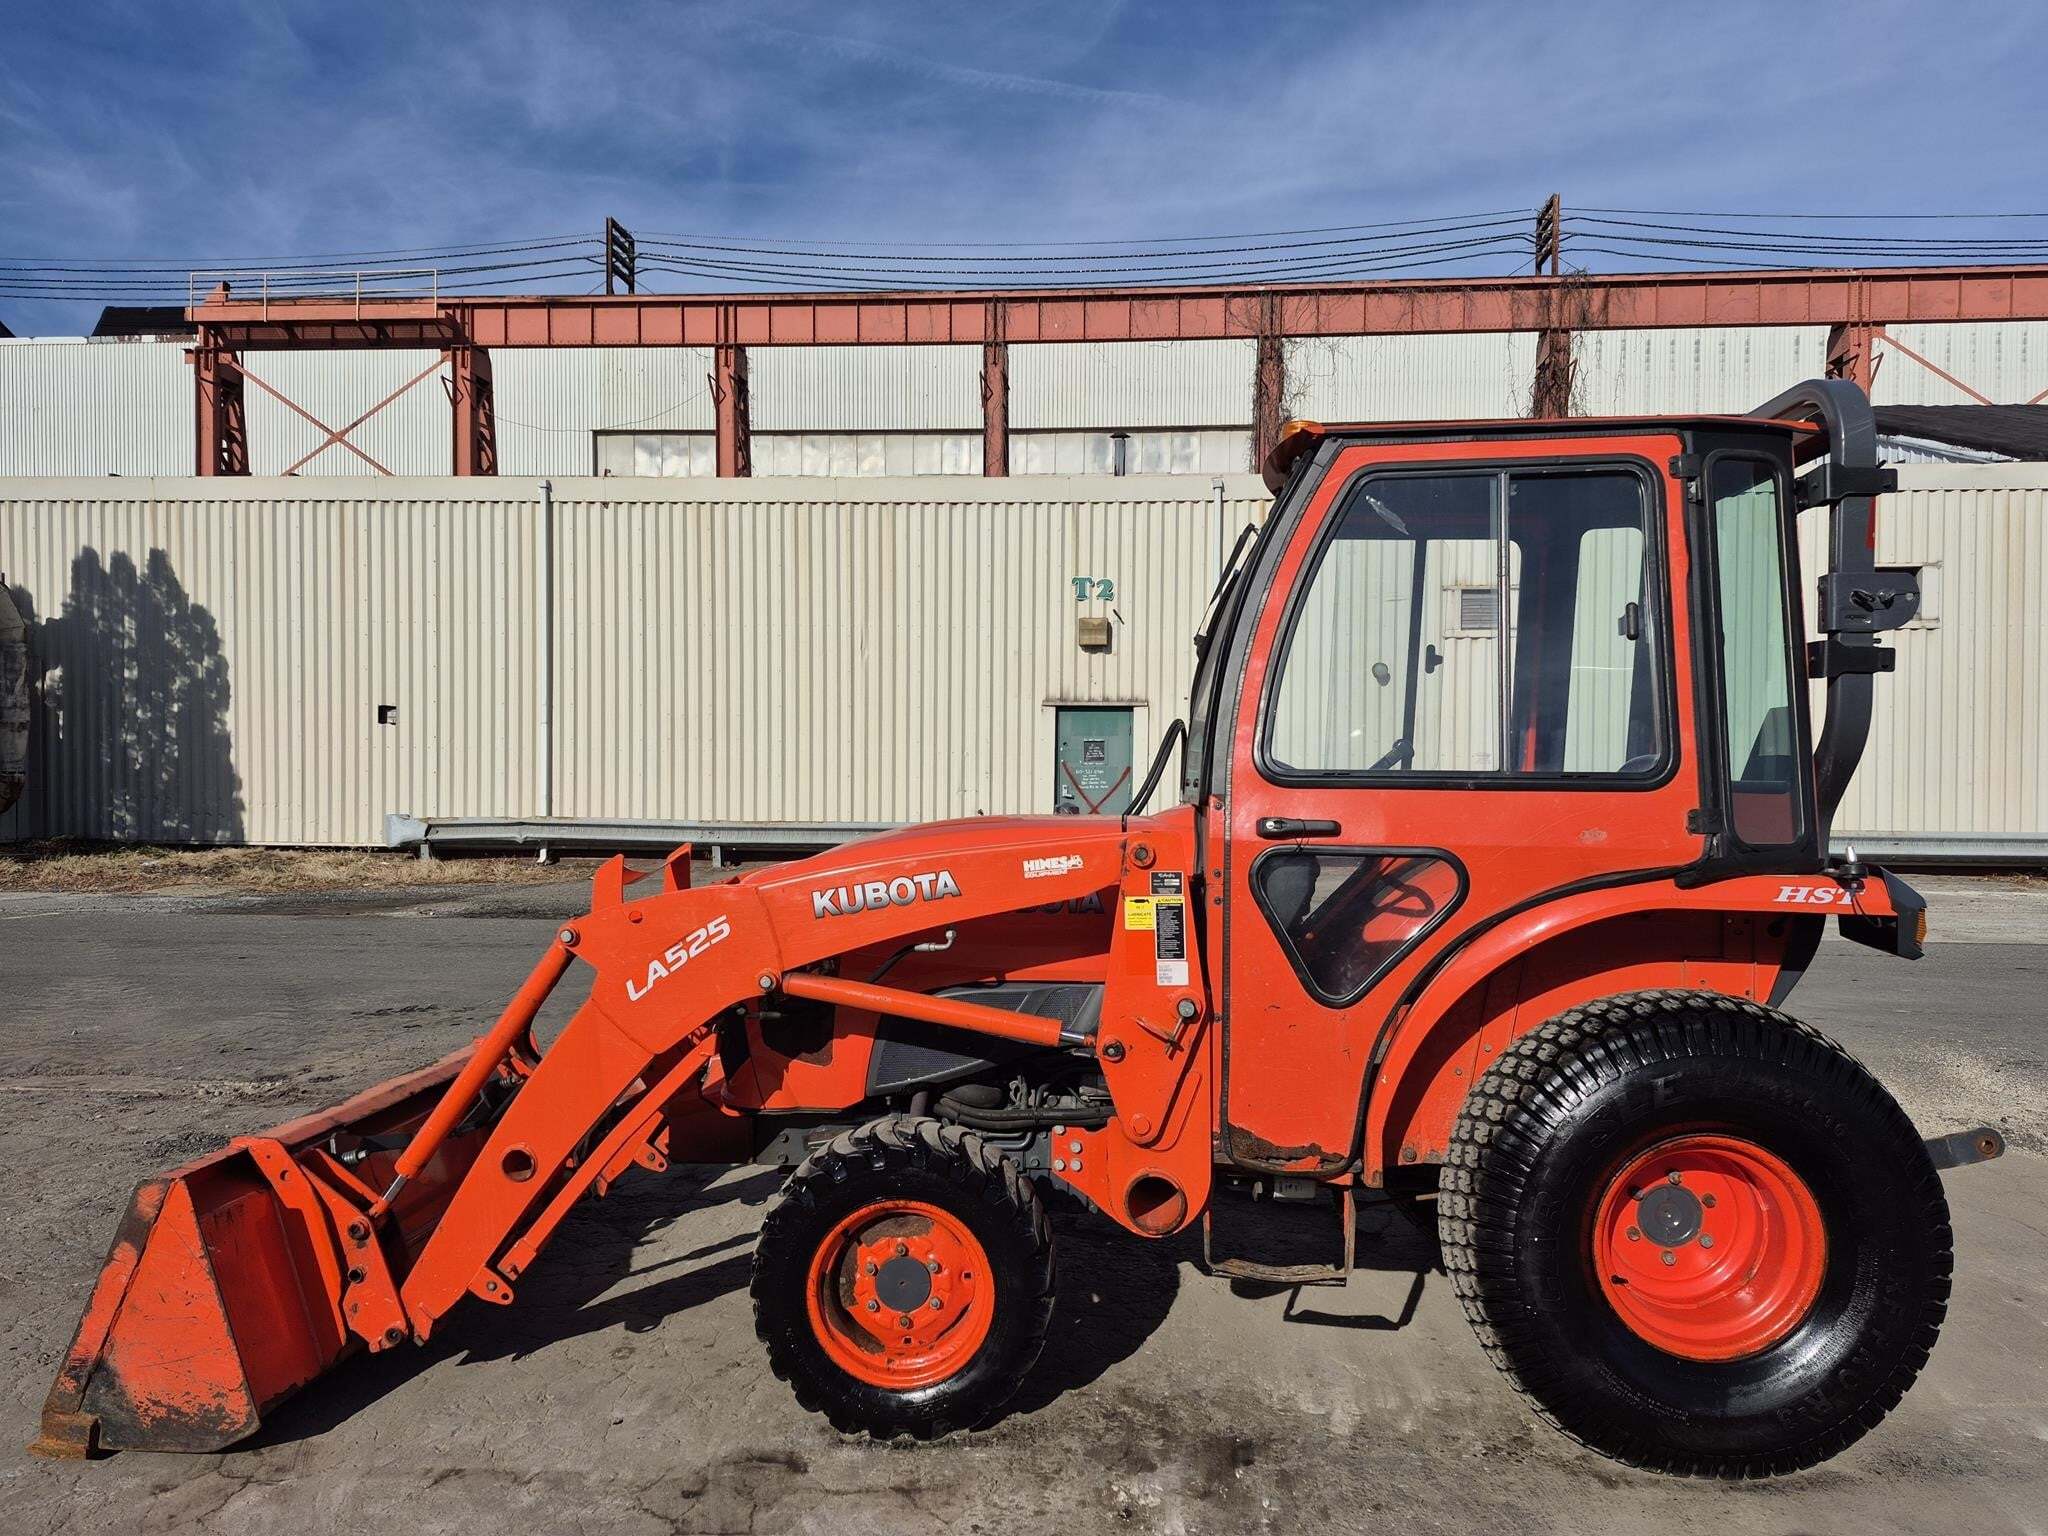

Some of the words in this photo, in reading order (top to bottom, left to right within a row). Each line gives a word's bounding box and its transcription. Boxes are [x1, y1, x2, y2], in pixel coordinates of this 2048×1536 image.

[1071, 576, 1114, 601] T2
[1023, 856, 1068, 872] HINES
[811, 869, 962, 919] KUBOTA
[1773, 886, 1853, 905] HST
[625, 914, 731, 1001] LA525
